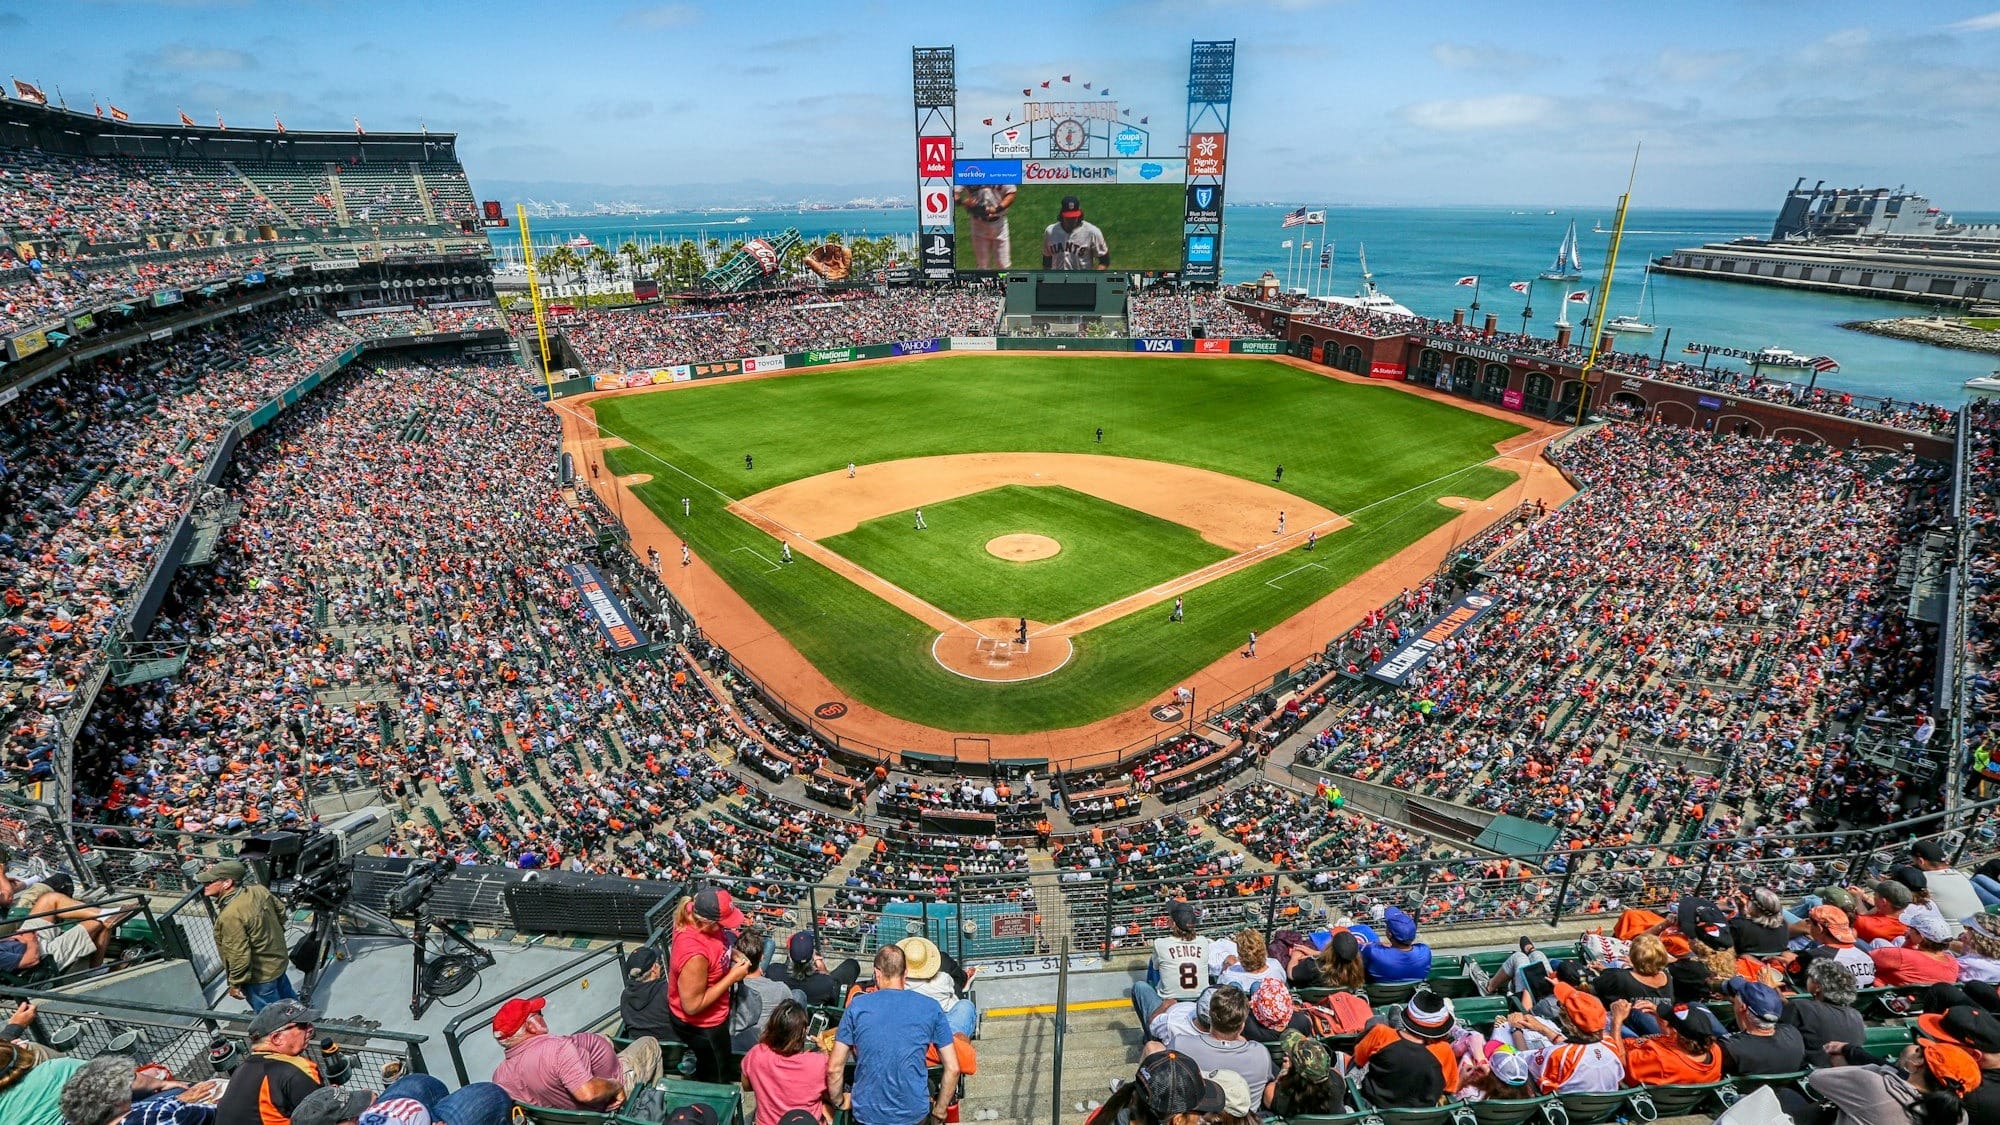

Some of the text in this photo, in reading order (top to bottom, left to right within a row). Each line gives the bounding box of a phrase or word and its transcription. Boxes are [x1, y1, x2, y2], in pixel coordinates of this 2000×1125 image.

[1119, 134, 1140, 142] coupa
[994, 144, 1029, 153] Fanatics
[1193, 158, 1218, 168] Dignity
[1026, 162, 1109, 180] Coors LIGHT
[540, 281, 634, 299] nuveen
[900, 340, 931, 352] YAHOO!
[1142, 340, 1174, 351] VISA
[818, 349, 850, 360] National
[1456, 346, 1509, 363] LANDING
[1688, 342, 1803, 368] BANK OF AMERICA
[757, 359, 783, 367] TOYOTA
[1376, 645, 1427, 679] WELCOME
[1412, 638, 1437, 650] TO
[1168, 945, 1203, 960] PENCE
[995, 959, 1027, 973] 315
[1178, 962, 1199, 990] 8
